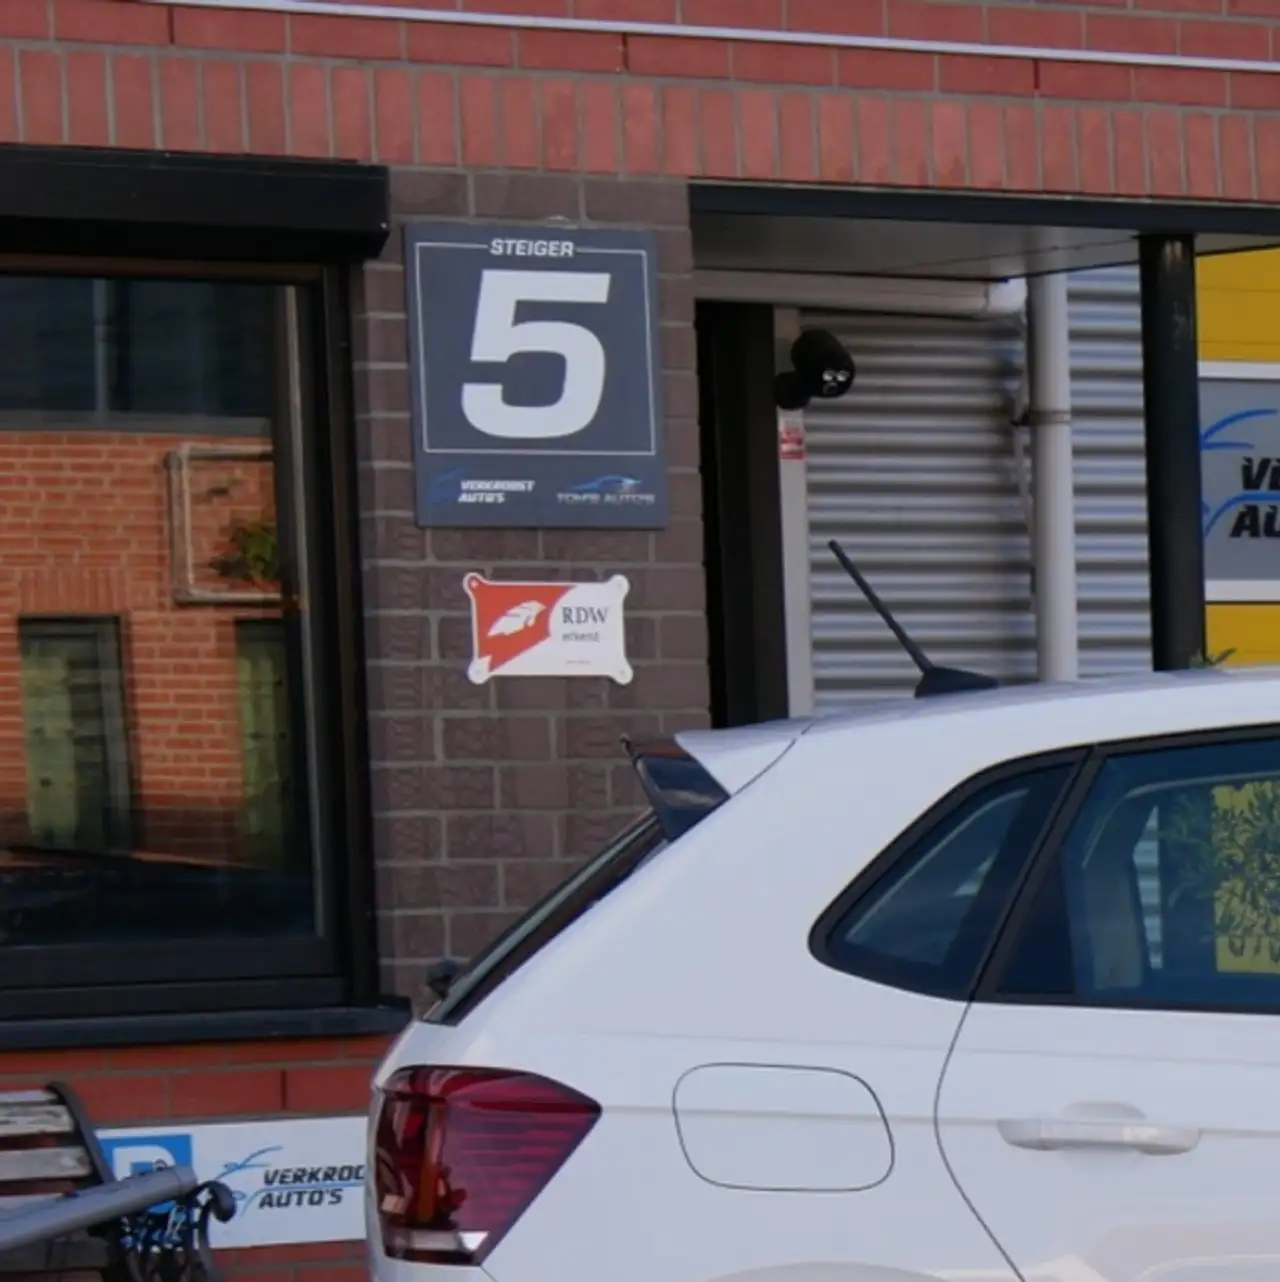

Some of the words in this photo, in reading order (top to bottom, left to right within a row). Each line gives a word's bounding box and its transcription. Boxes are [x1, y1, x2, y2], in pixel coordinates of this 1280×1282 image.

[490, 238, 574, 257] STEIGER
[461, 269, 611, 438] 5
[562, 606, 609, 625] RDW
[258, 1187, 344, 1210] AUTO'S
